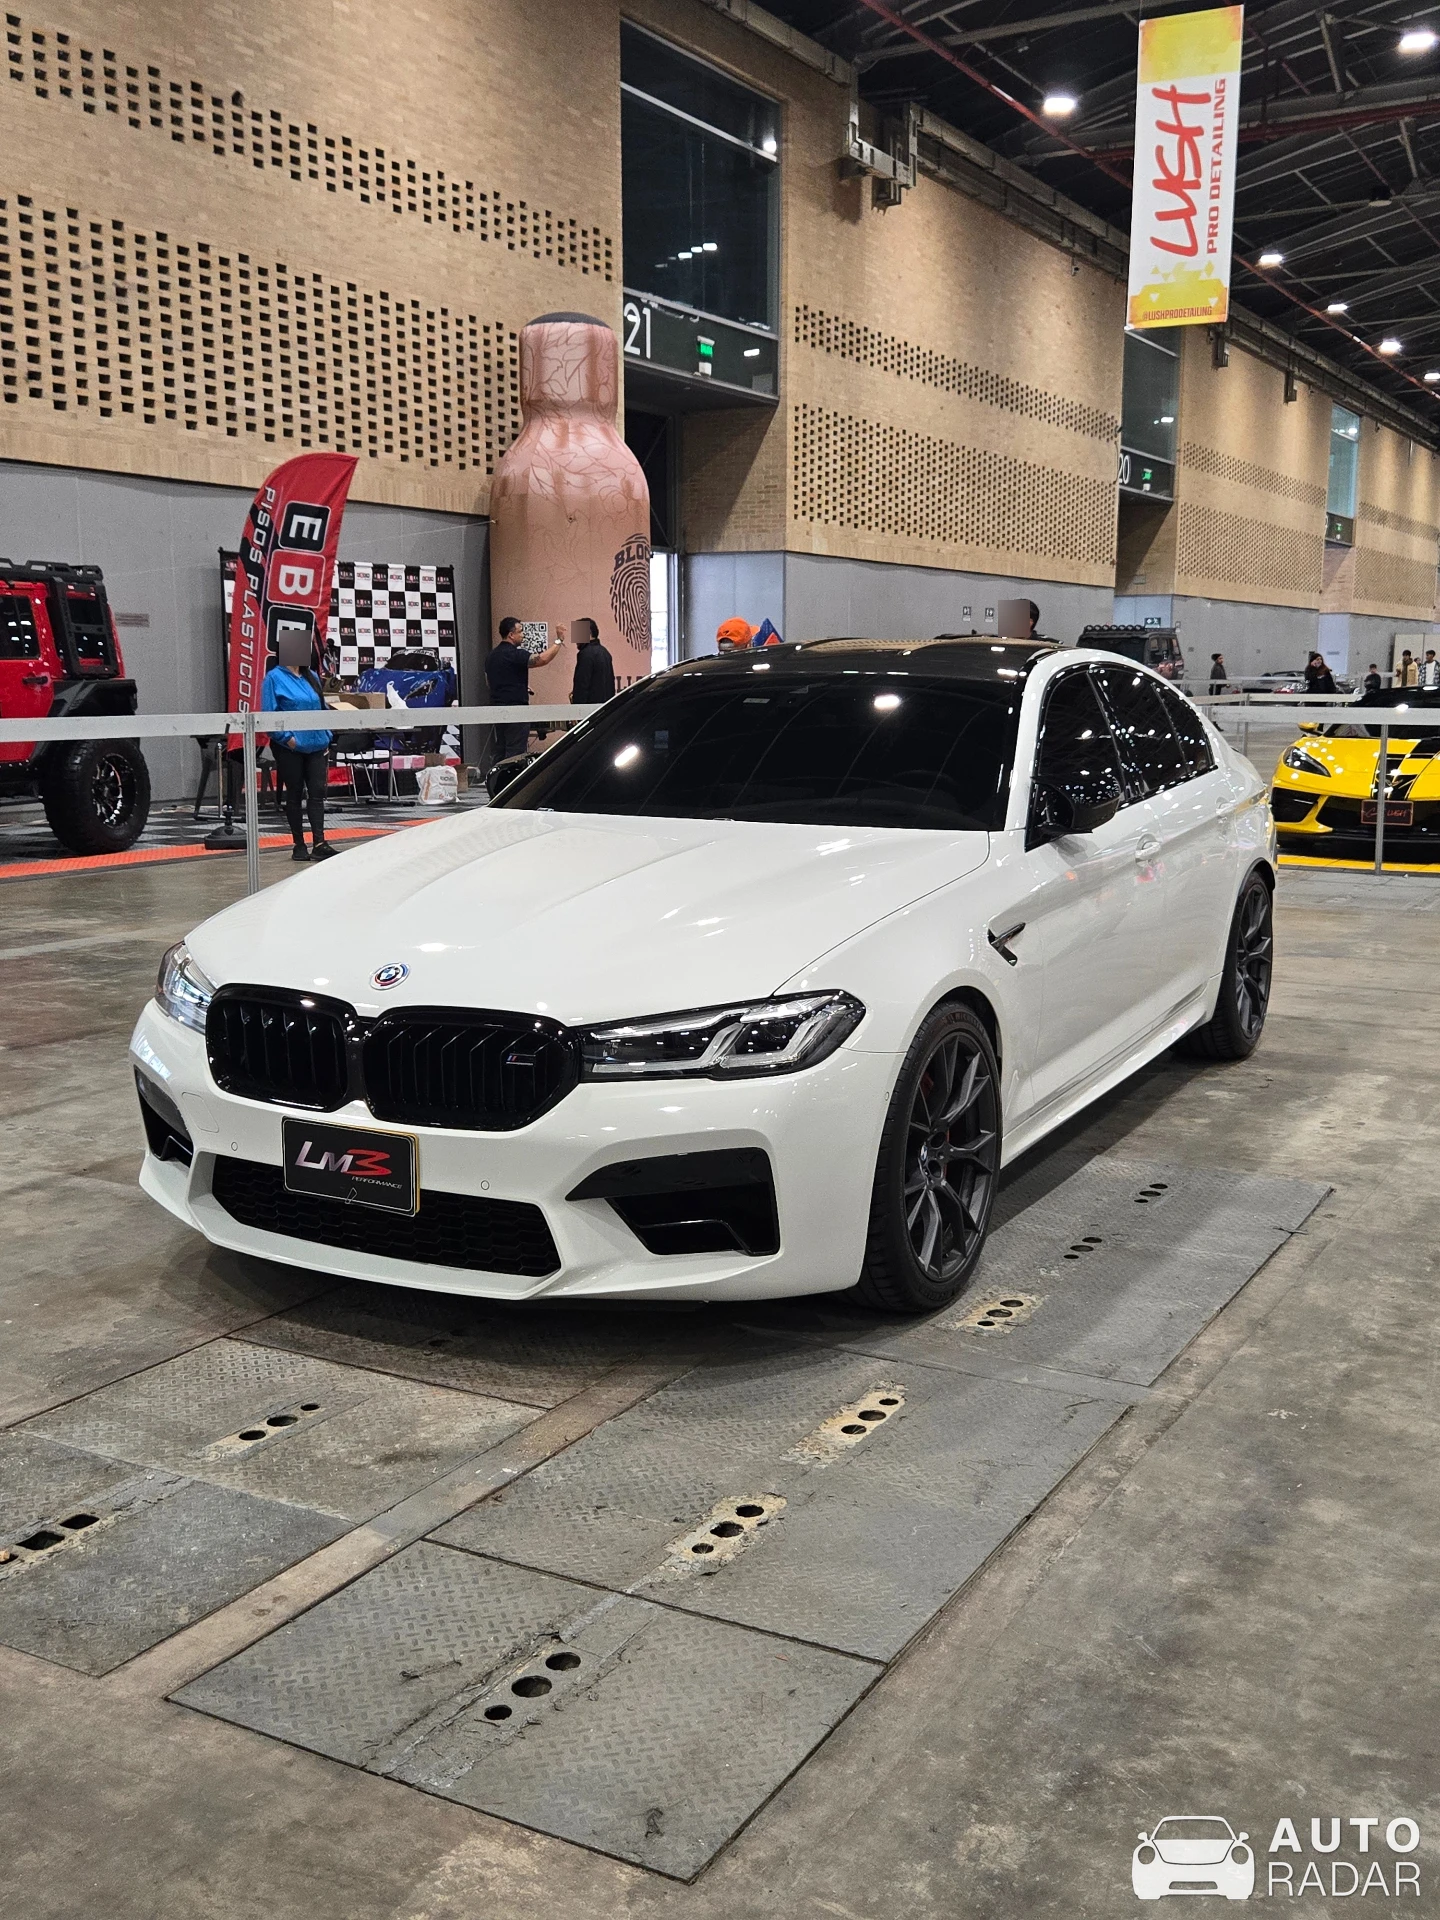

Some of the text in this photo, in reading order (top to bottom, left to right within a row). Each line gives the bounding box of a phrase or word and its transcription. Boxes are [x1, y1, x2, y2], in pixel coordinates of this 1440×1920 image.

[1150, 84, 1211, 257] LUSH
[1206, 78, 1227, 254] PRO DETAILING
[624, 302, 651, 359] 21
[1142, 306, 1213, 321] @LUSHPRODETAILING
[249, 486, 276, 564] PISOS
[238, 573, 259, 713] PLASTICOS
[295, 1141, 392, 1176] LM3
[351, 1176, 403, 1190] PERFORMANCE
